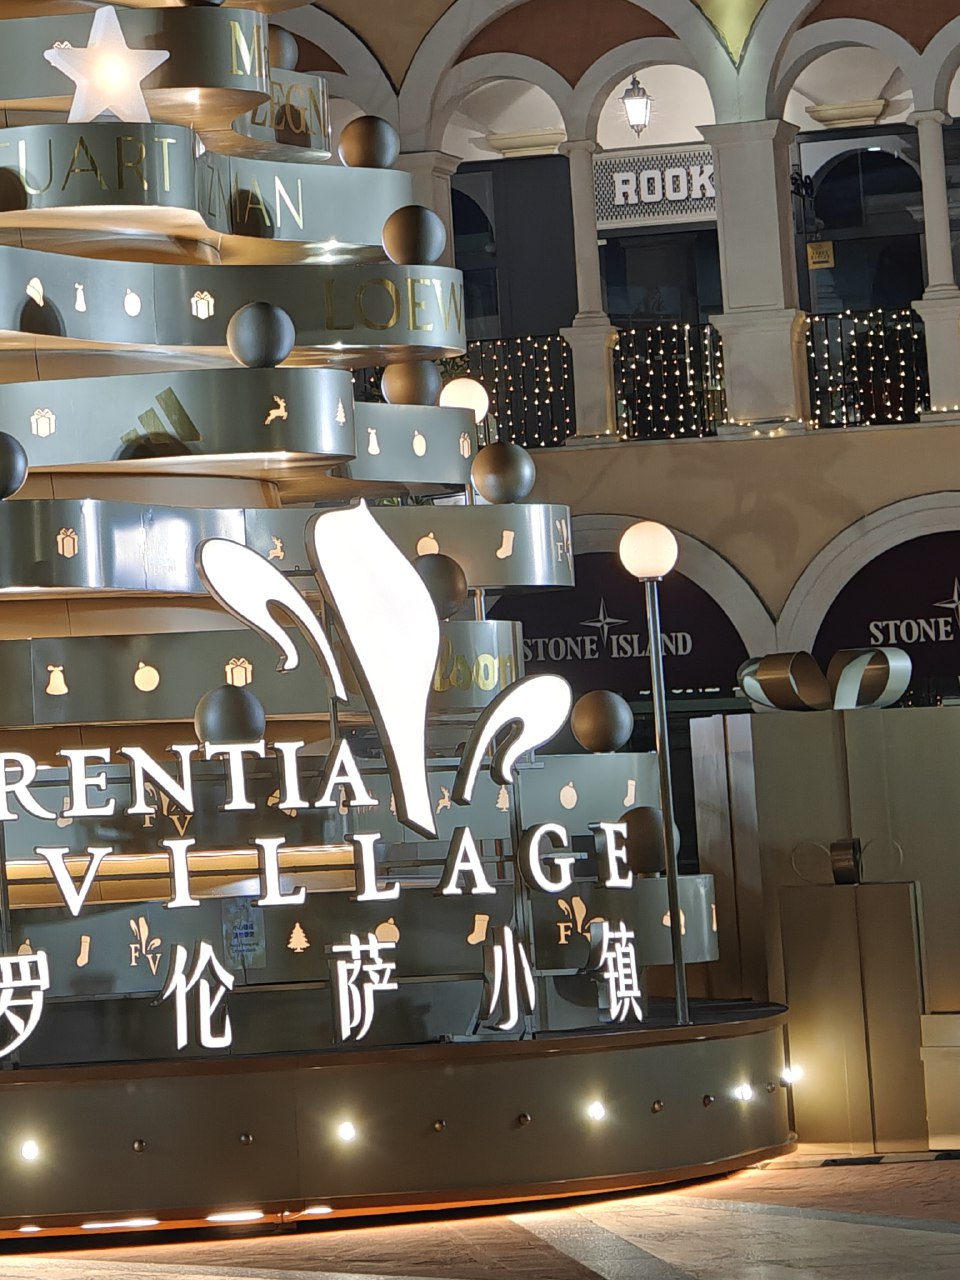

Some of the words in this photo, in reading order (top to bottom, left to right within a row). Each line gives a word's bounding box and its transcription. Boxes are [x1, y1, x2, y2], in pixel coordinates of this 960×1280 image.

[869, 617, 954, 645] STONE
[522, 635, 600, 662] STONE
[610, 632, 693, 658] ISLND
[36, 822, 634, 917] VILLAGE
